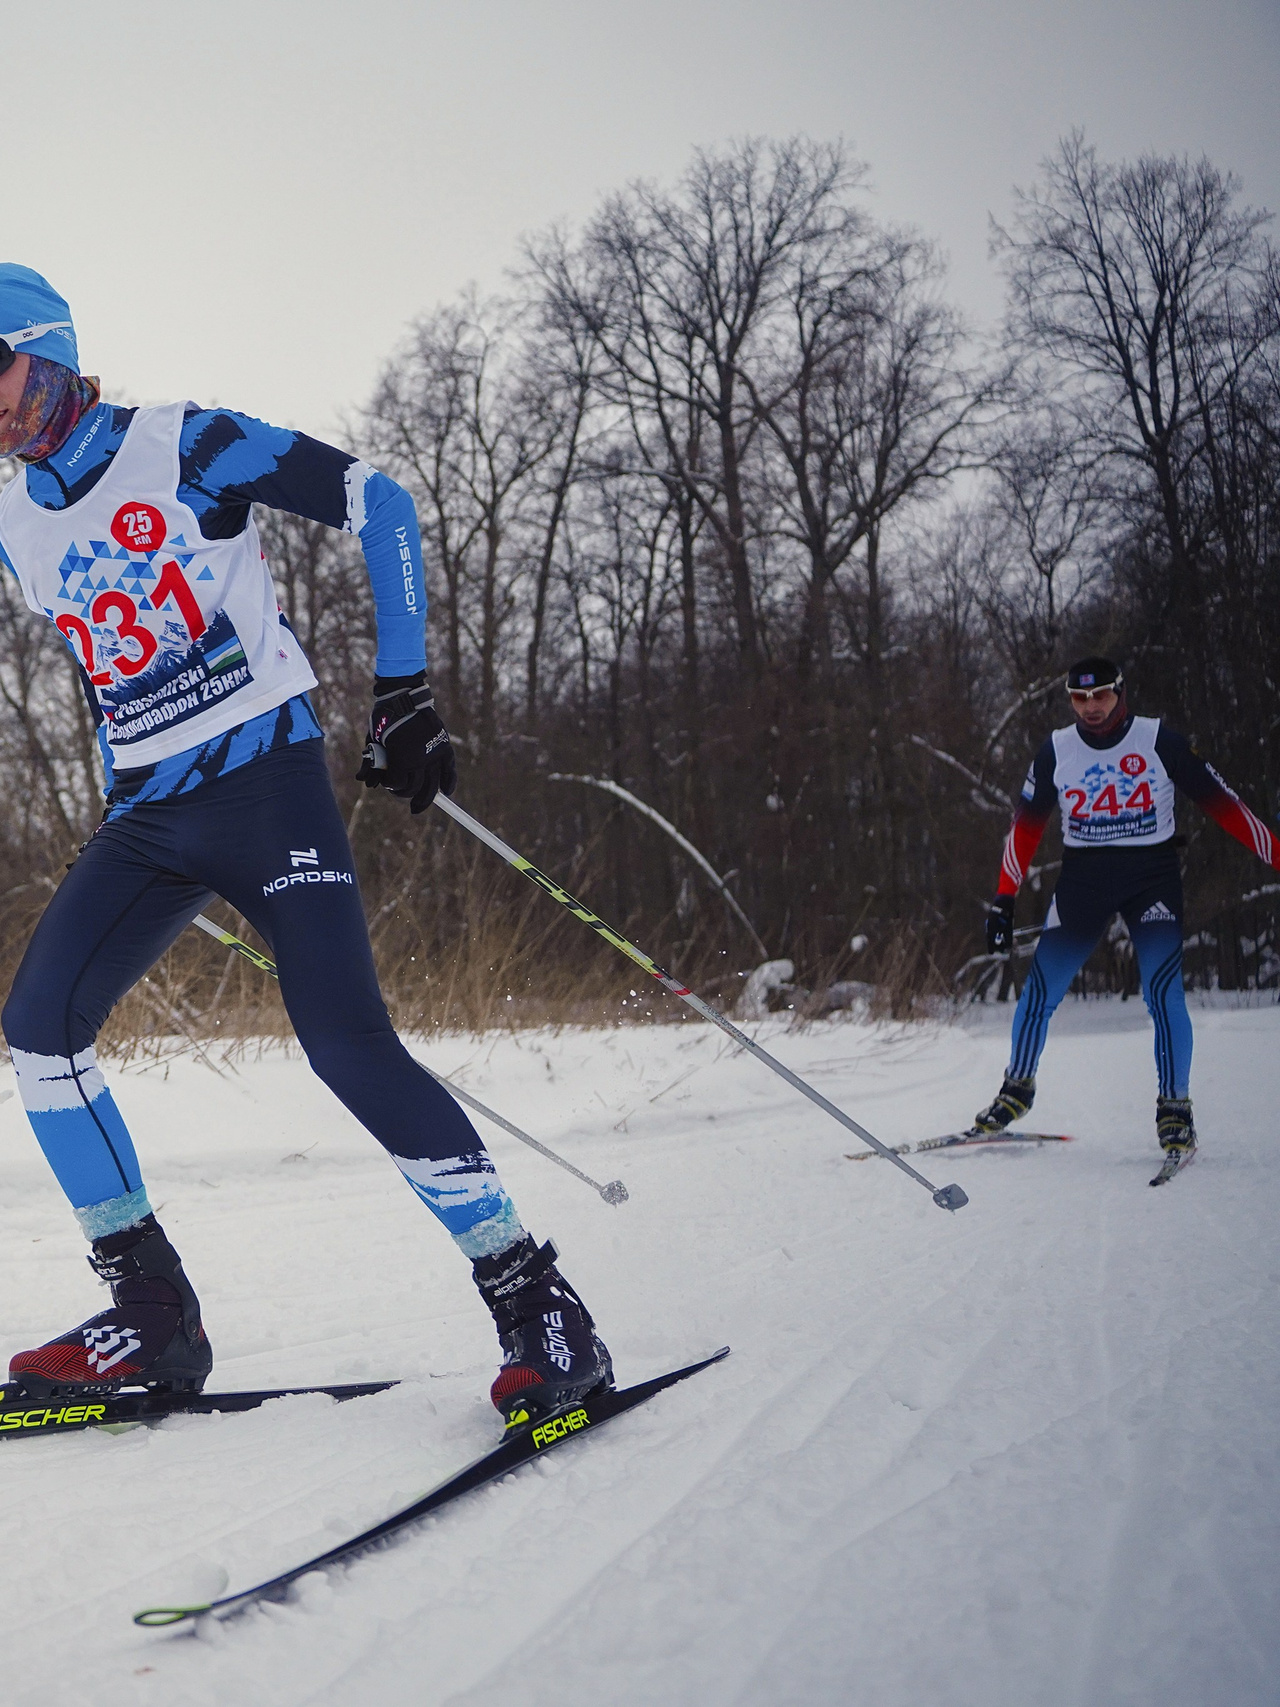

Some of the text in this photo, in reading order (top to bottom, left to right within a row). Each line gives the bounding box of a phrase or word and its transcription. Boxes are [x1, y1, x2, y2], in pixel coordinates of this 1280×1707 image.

[66, 415, 104, 468] NORDSKI
[122, 510, 153, 537] 25
[394, 526, 419, 615] NORDSKI
[55, 560, 207, 686] 231
[1065, 781, 1154, 818] 244
[263, 871, 353, 897] NORDSKI
[1140, 911, 1176, 923] adidas
[493, 1275, 525, 1297] alpina
[542, 1310, 576, 1373] alpina
[532, 1408, 591, 1449] FISCHER
